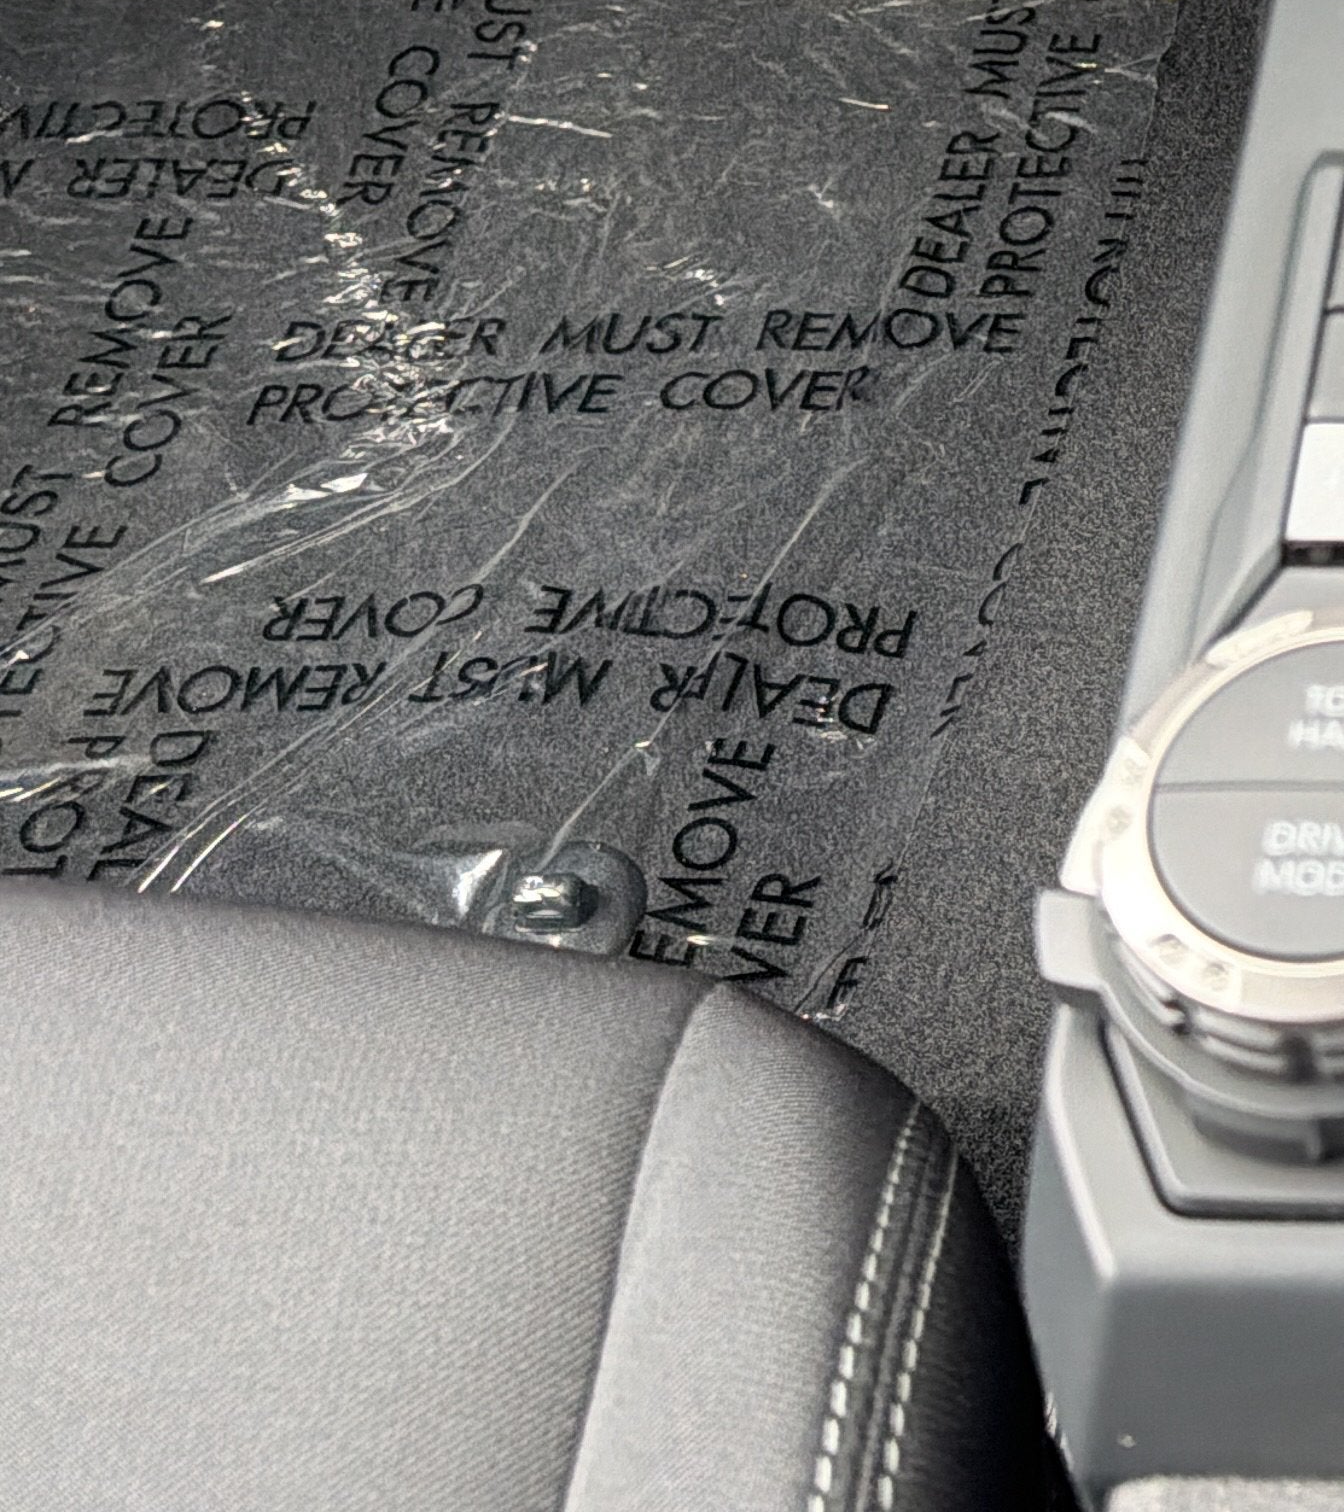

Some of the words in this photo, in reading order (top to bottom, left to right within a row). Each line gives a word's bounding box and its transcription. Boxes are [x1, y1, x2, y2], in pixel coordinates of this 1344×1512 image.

[67, 158, 294, 200] DEALER
[337, 45, 441, 208] COVER
[379, 102, 500, 304] REMOVE
[979, 33, 1101, 298] PROTECTIVE
[898, 133, 1000, 298] DEALER
[47, 215, 193, 429] REMOVE
[104, 313, 233, 488] COVER
[246, 372, 623, 426] PROCTIVE
[659, 368, 879, 413] COVER
[274, 317, 506, 362] DEER
[539, 313, 721, 355] MUST
[755, 307, 1025, 354] REMOVE
[83, 661, 387, 719] REMOVE
[260, 583, 484, 643] COVER
